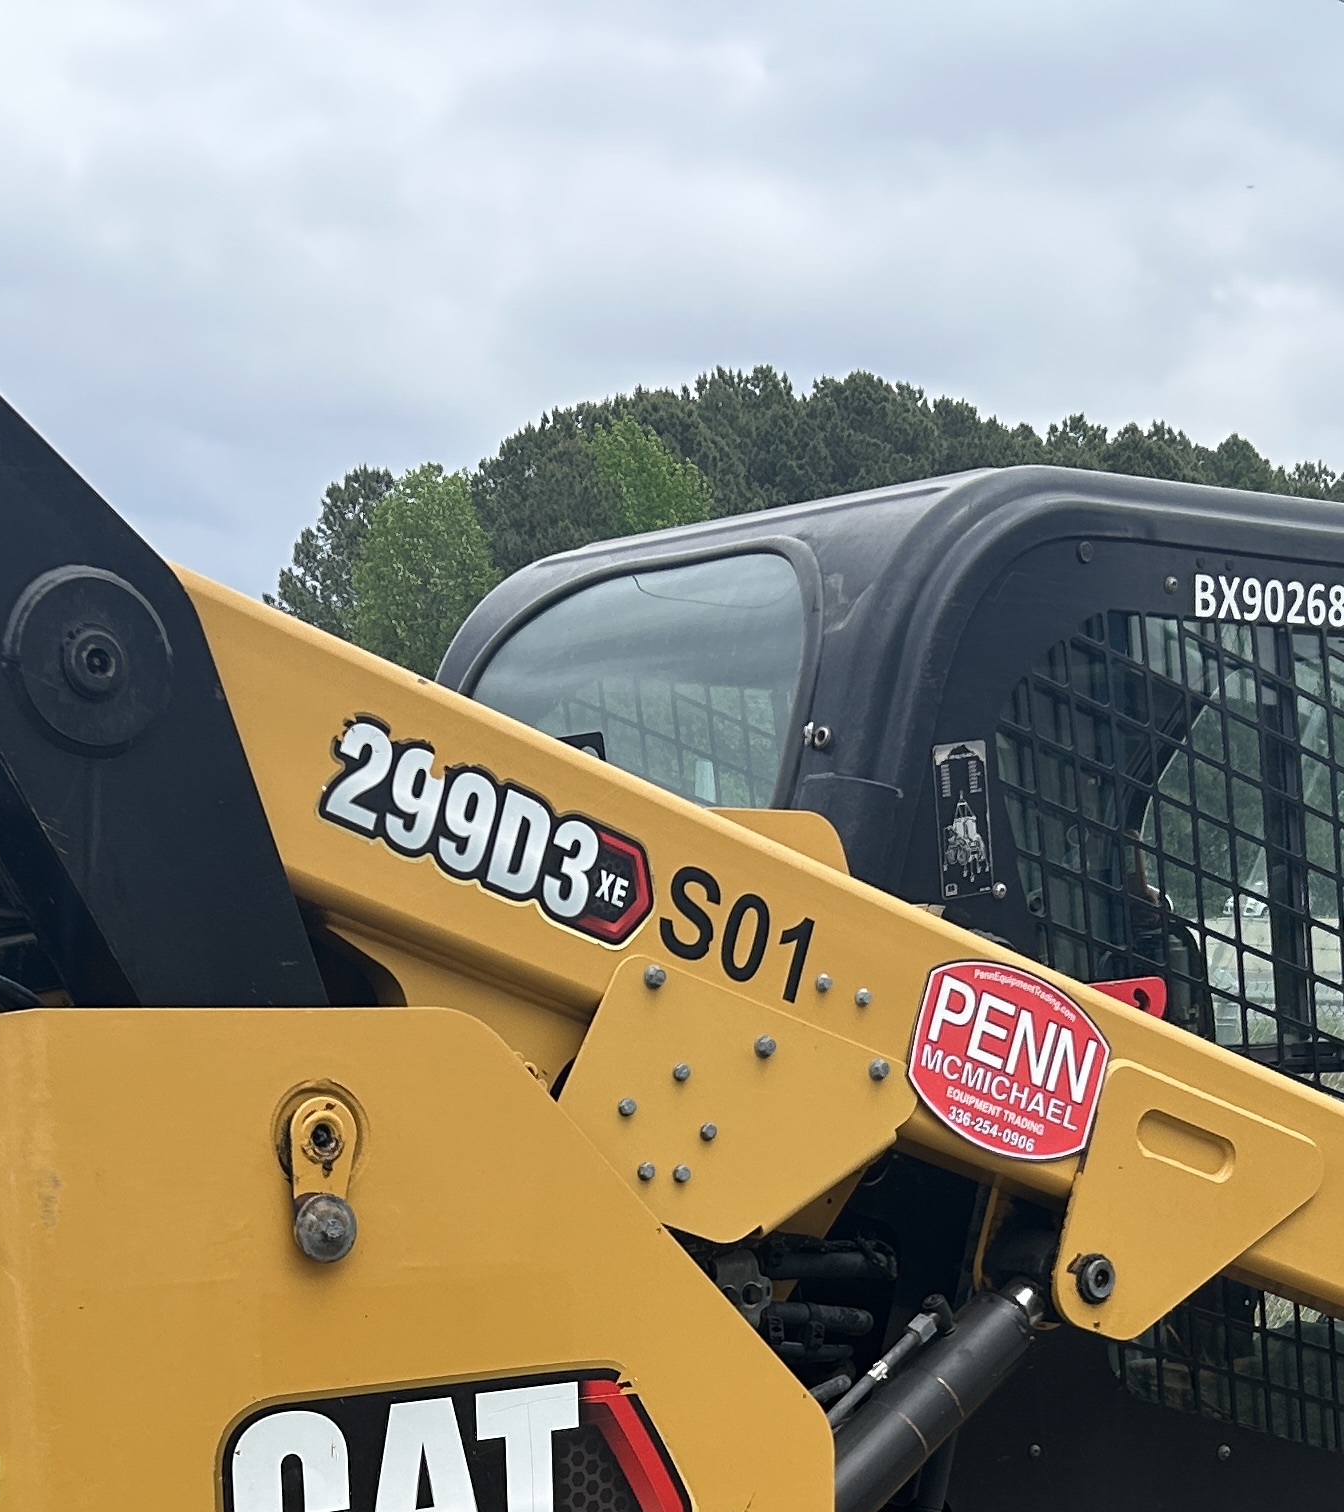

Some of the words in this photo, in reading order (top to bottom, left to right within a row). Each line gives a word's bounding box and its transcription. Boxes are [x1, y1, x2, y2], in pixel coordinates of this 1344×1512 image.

[325, 722, 599, 917] 299D3
[595, 870, 629, 908] XE
[660, 866, 815, 1004] S01
[921, 1044, 1077, 1131] MCMICHAEL
[927, 974, 1097, 1104] PENN
[946, 1086, 1002, 1117] EQUIPMENT
[1003, 1109, 1044, 1136] TRADING
[948, 1105, 1035, 1152] 336-254-0906
